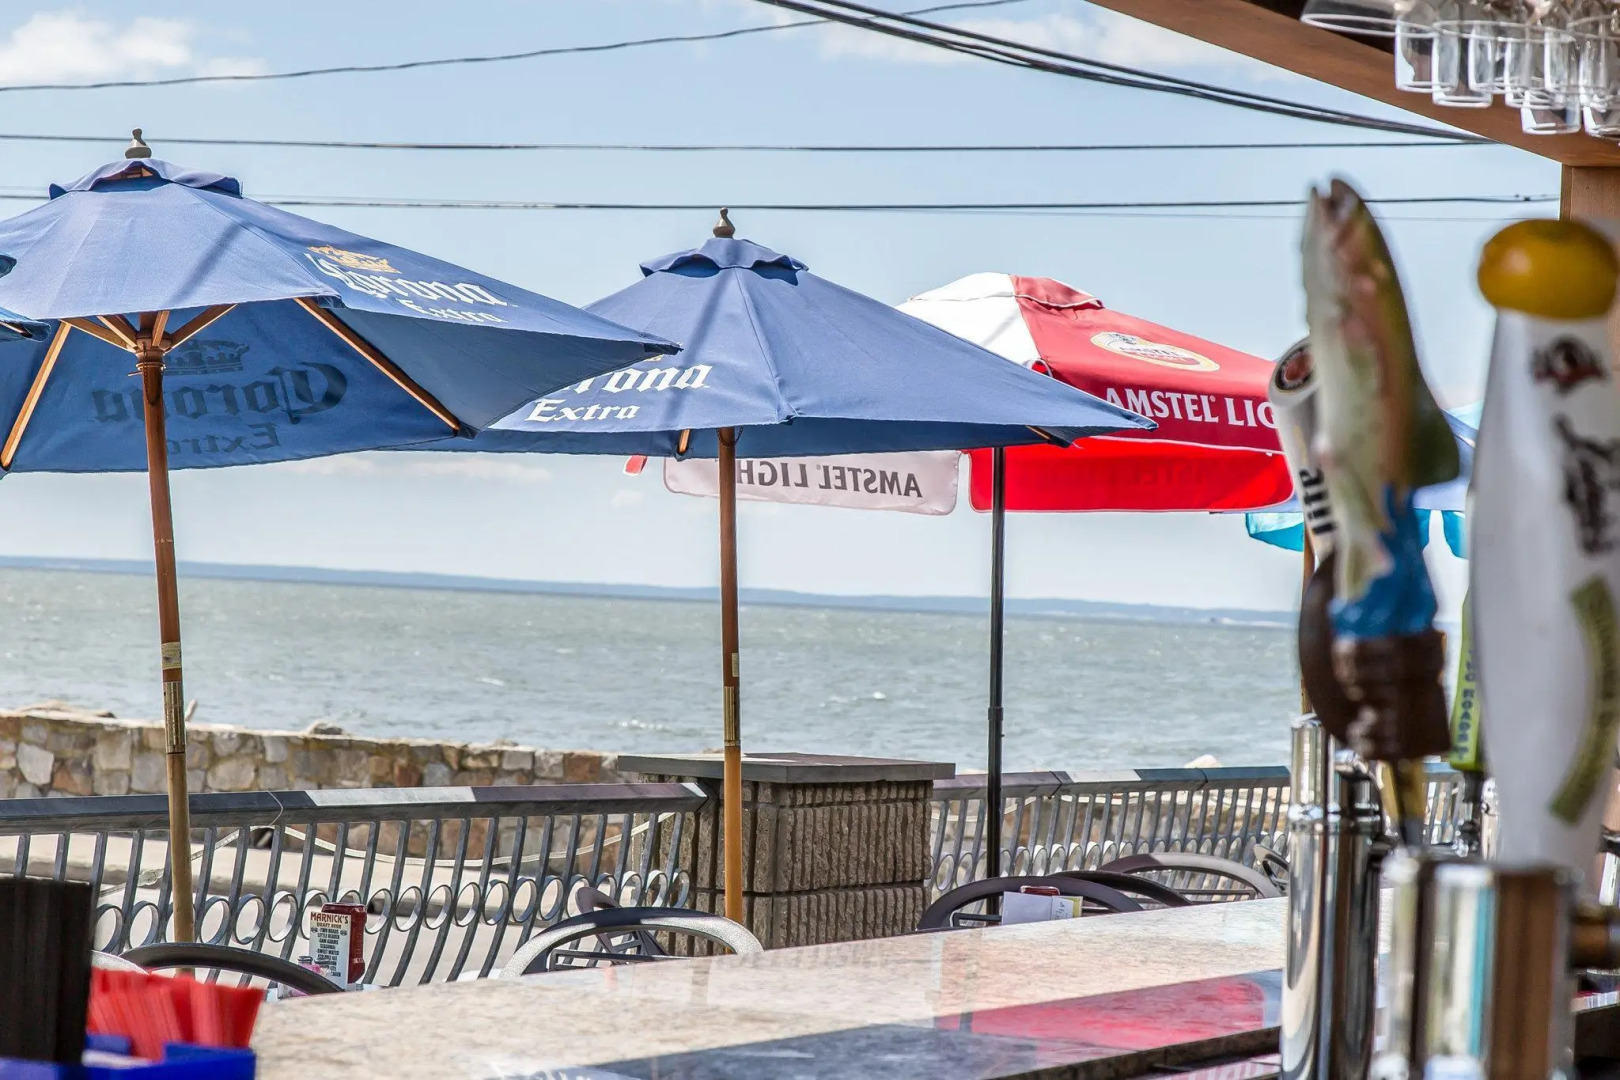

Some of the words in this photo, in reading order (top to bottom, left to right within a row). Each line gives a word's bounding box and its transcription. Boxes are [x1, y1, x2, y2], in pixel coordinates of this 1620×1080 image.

[560, 364, 713, 395] rona
[525, 398, 641, 422] Extra
[310, 912, 349, 924] MARNICK'S
